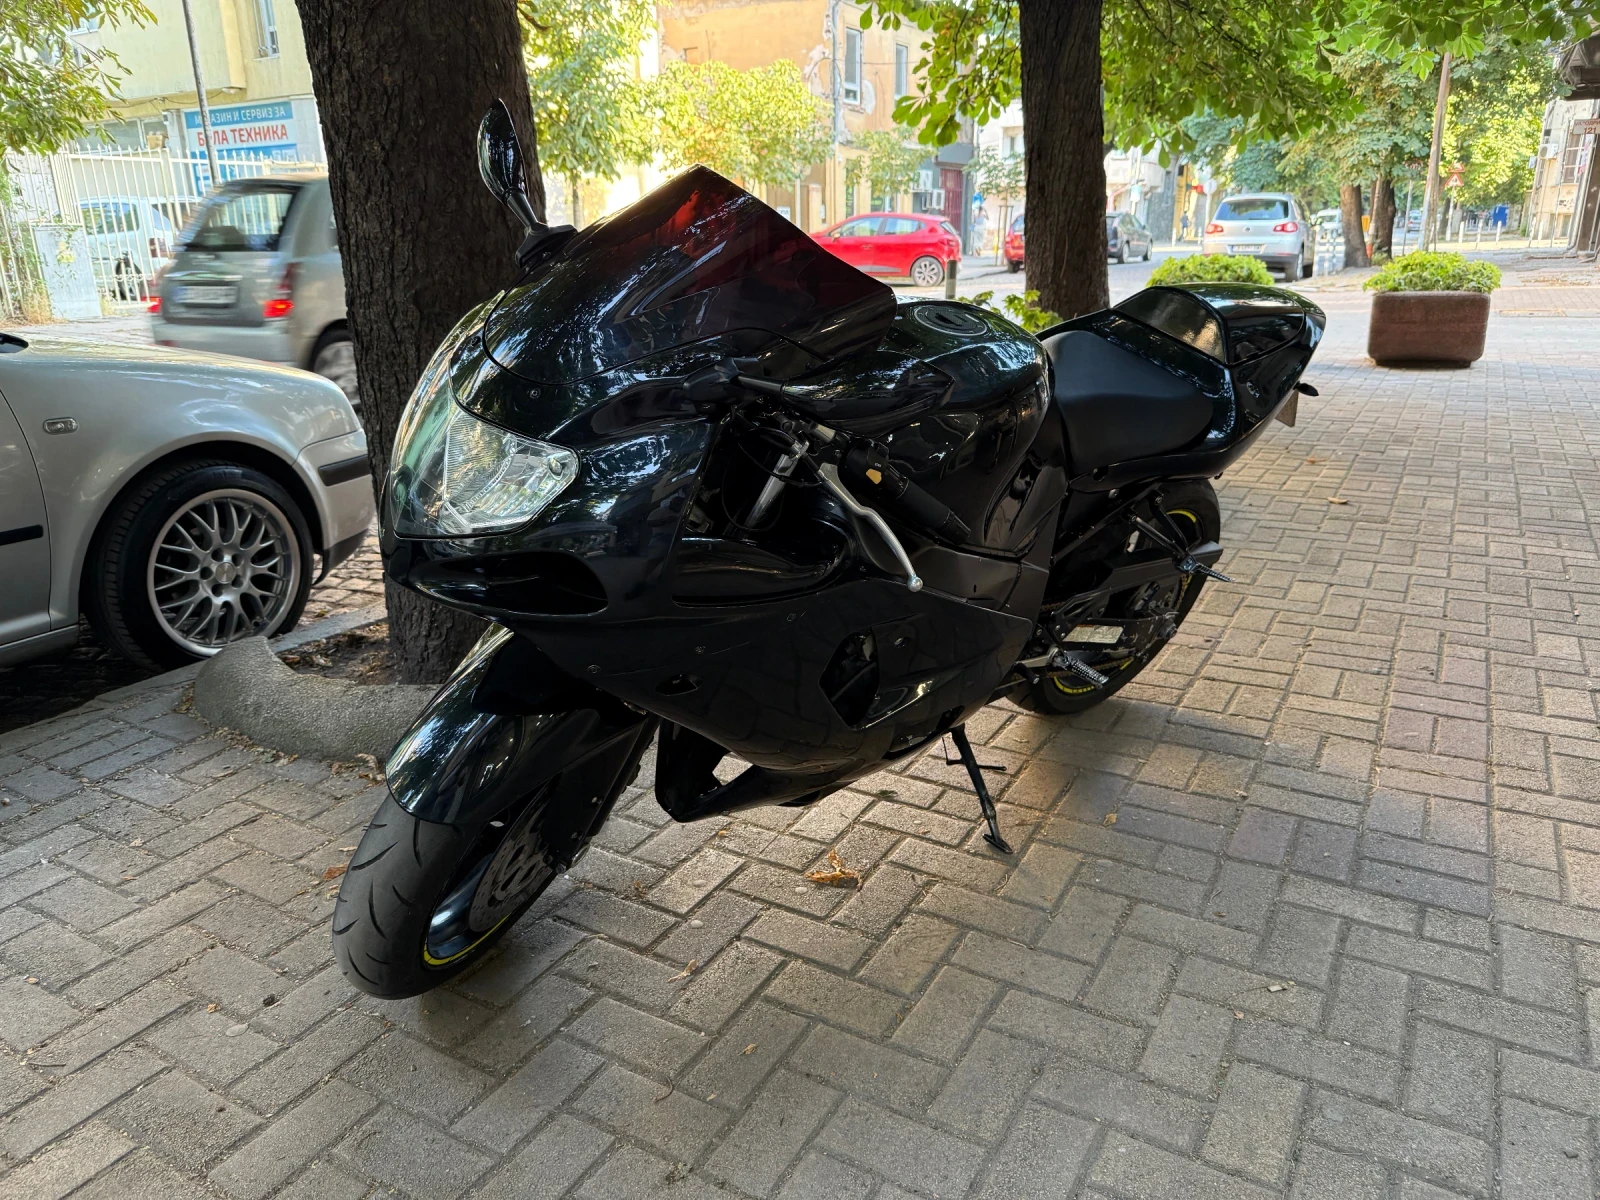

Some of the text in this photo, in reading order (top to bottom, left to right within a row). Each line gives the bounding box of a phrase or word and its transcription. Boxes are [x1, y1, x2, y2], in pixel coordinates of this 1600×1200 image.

[194, 111, 232, 125] МАЗИН
[241, 108, 273, 121] СЕРВИЗ
[274, 106, 286, 117] ЗА
[196, 124, 289, 147] БЛА ТЕХНИКА
